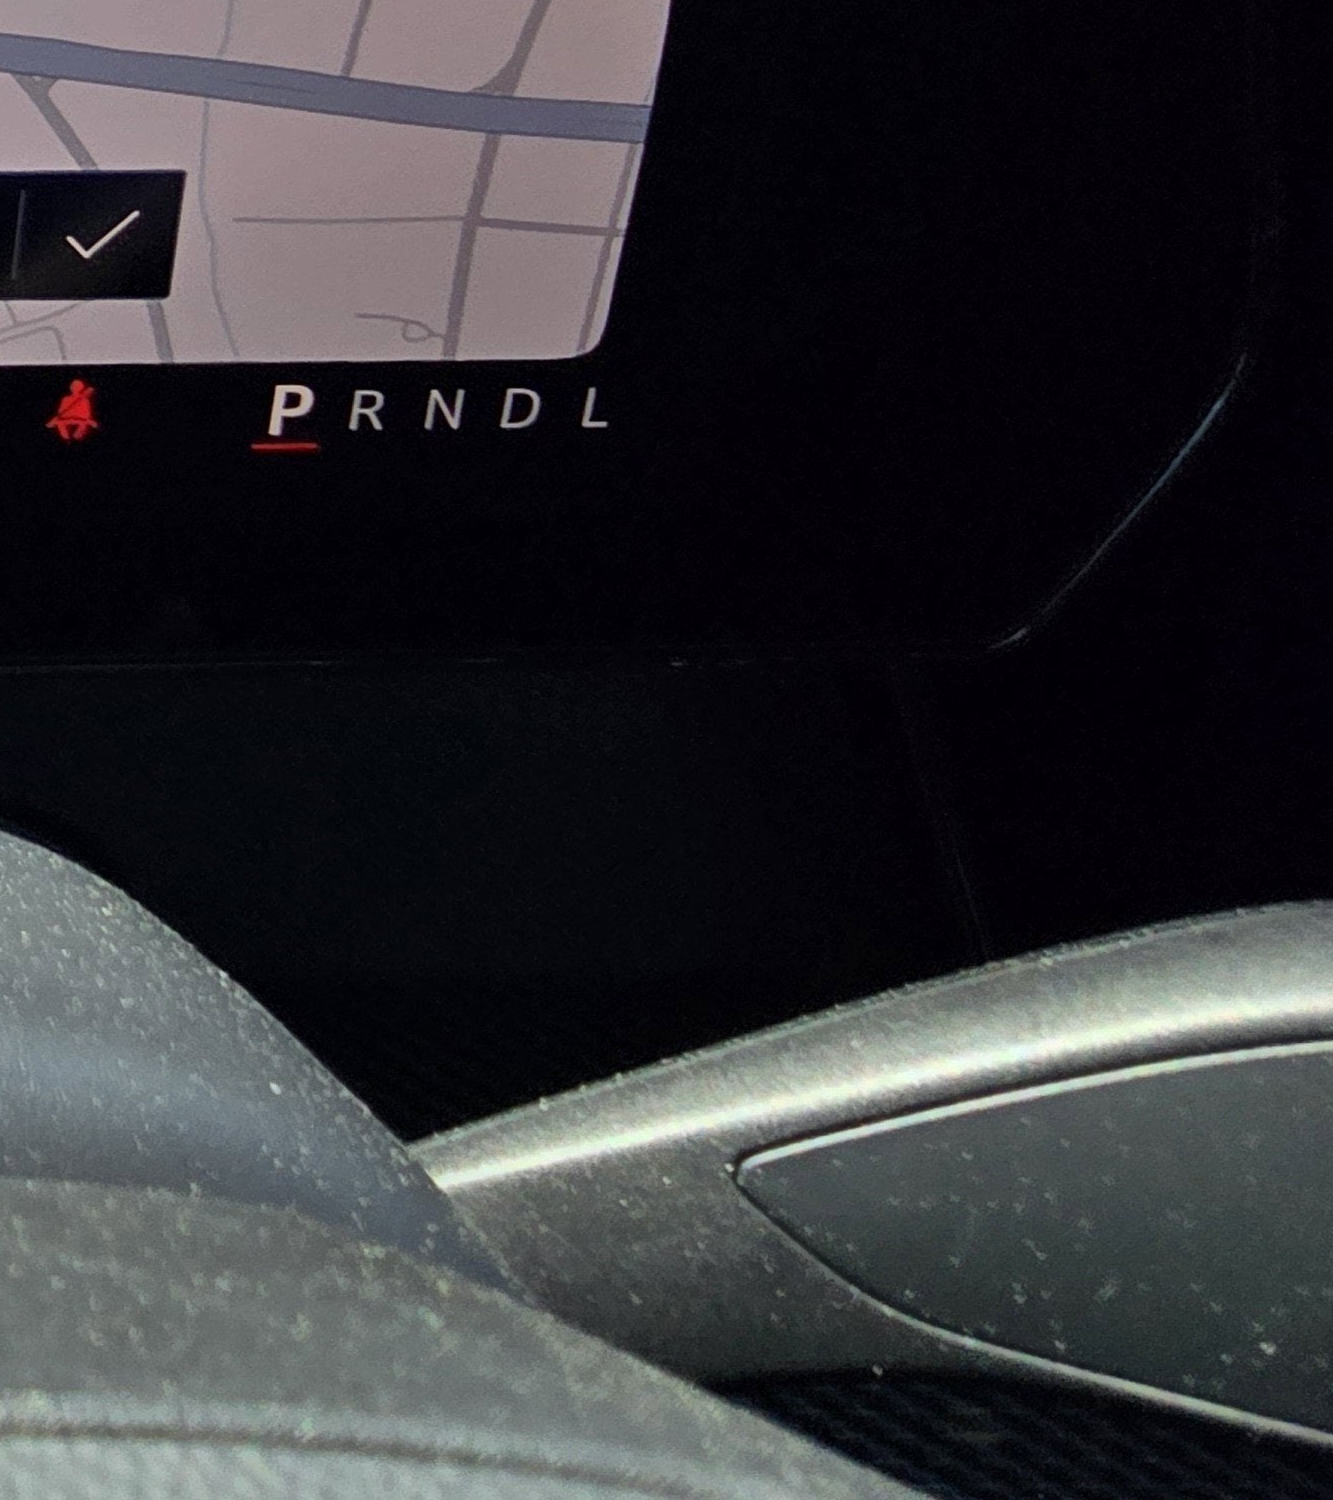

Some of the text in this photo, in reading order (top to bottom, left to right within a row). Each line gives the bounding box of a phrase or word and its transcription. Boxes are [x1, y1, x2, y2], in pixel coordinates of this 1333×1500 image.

[268, 384, 609, 437] P R N D L
